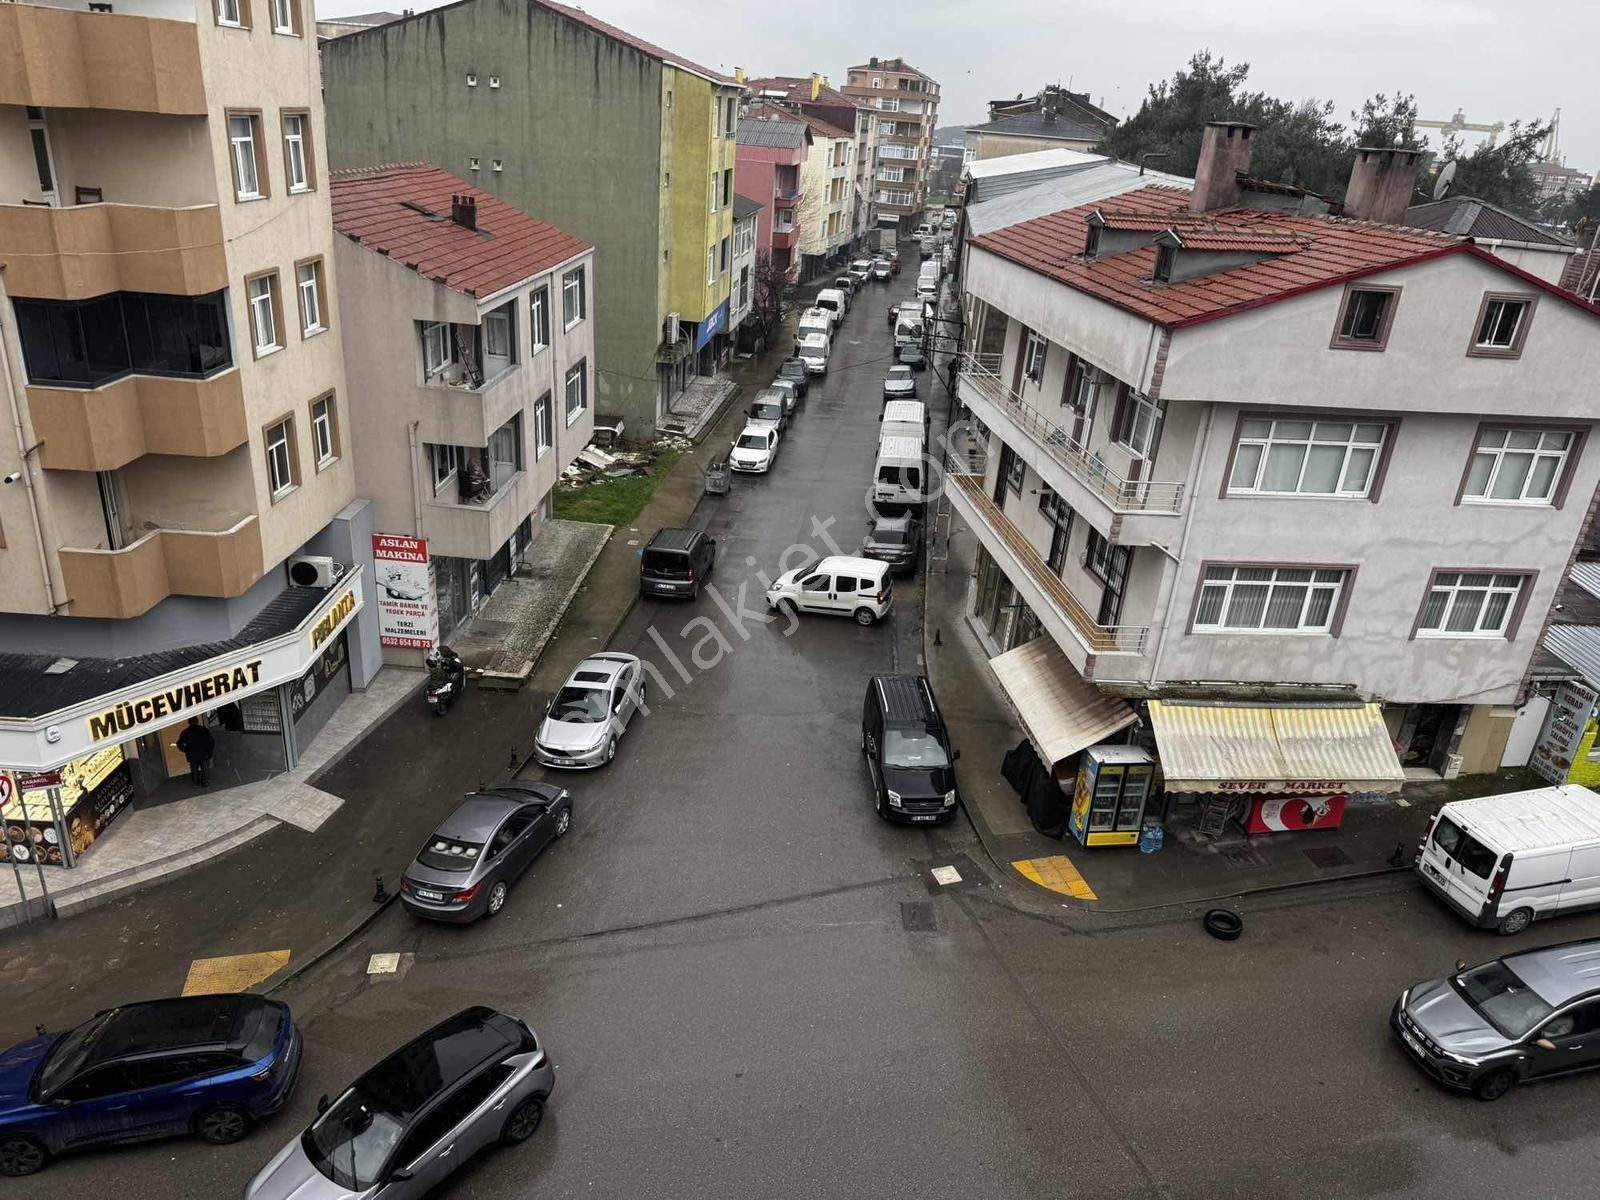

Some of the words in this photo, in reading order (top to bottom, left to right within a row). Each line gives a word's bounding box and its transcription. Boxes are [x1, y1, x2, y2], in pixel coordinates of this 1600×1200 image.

[379, 538, 418, 549] ASLAN
[375, 549, 424, 561] MAKİNA
[406, 610, 425, 618] PARÇA
[382, 637, 399, 645] 0532
[422, 640, 431, 648] 73
[89, 660, 262, 742] MÜCEVHERAT
[1564, 694, 1584, 710] KEBAP
[1217, 782, 1267, 790] SEVER
[1283, 781, 1346, 790] MARKET
